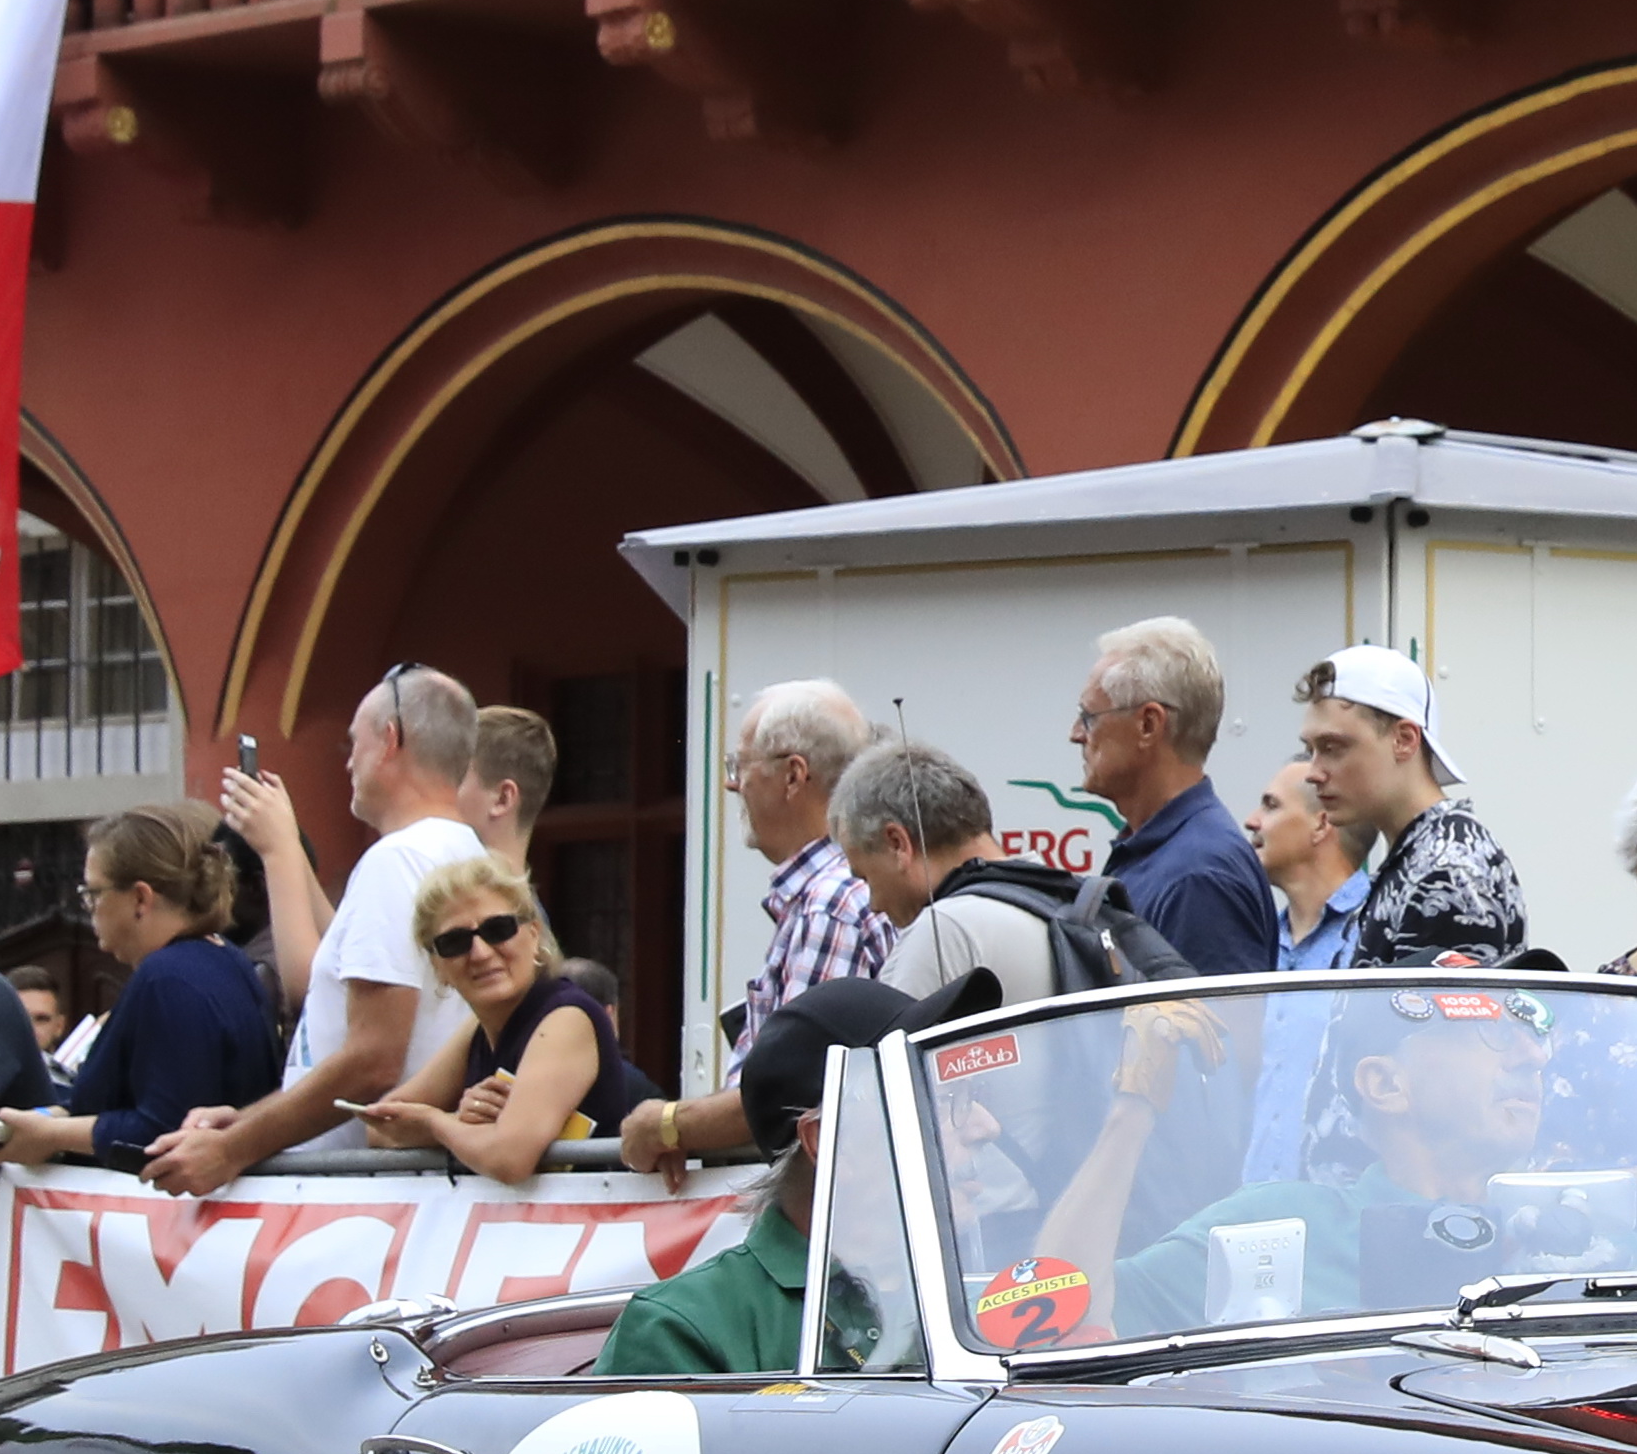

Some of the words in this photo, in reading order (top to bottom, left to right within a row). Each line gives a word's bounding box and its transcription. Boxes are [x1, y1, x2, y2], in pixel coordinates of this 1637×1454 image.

[1440, 996, 1481, 1007] 1000
[943, 1047, 1013, 1077] Alfaclub
[981, 1286, 1030, 1311] ACCES
[1034, 1274, 1079, 1294] PISTE
[1011, 1297, 1061, 1349] 2
